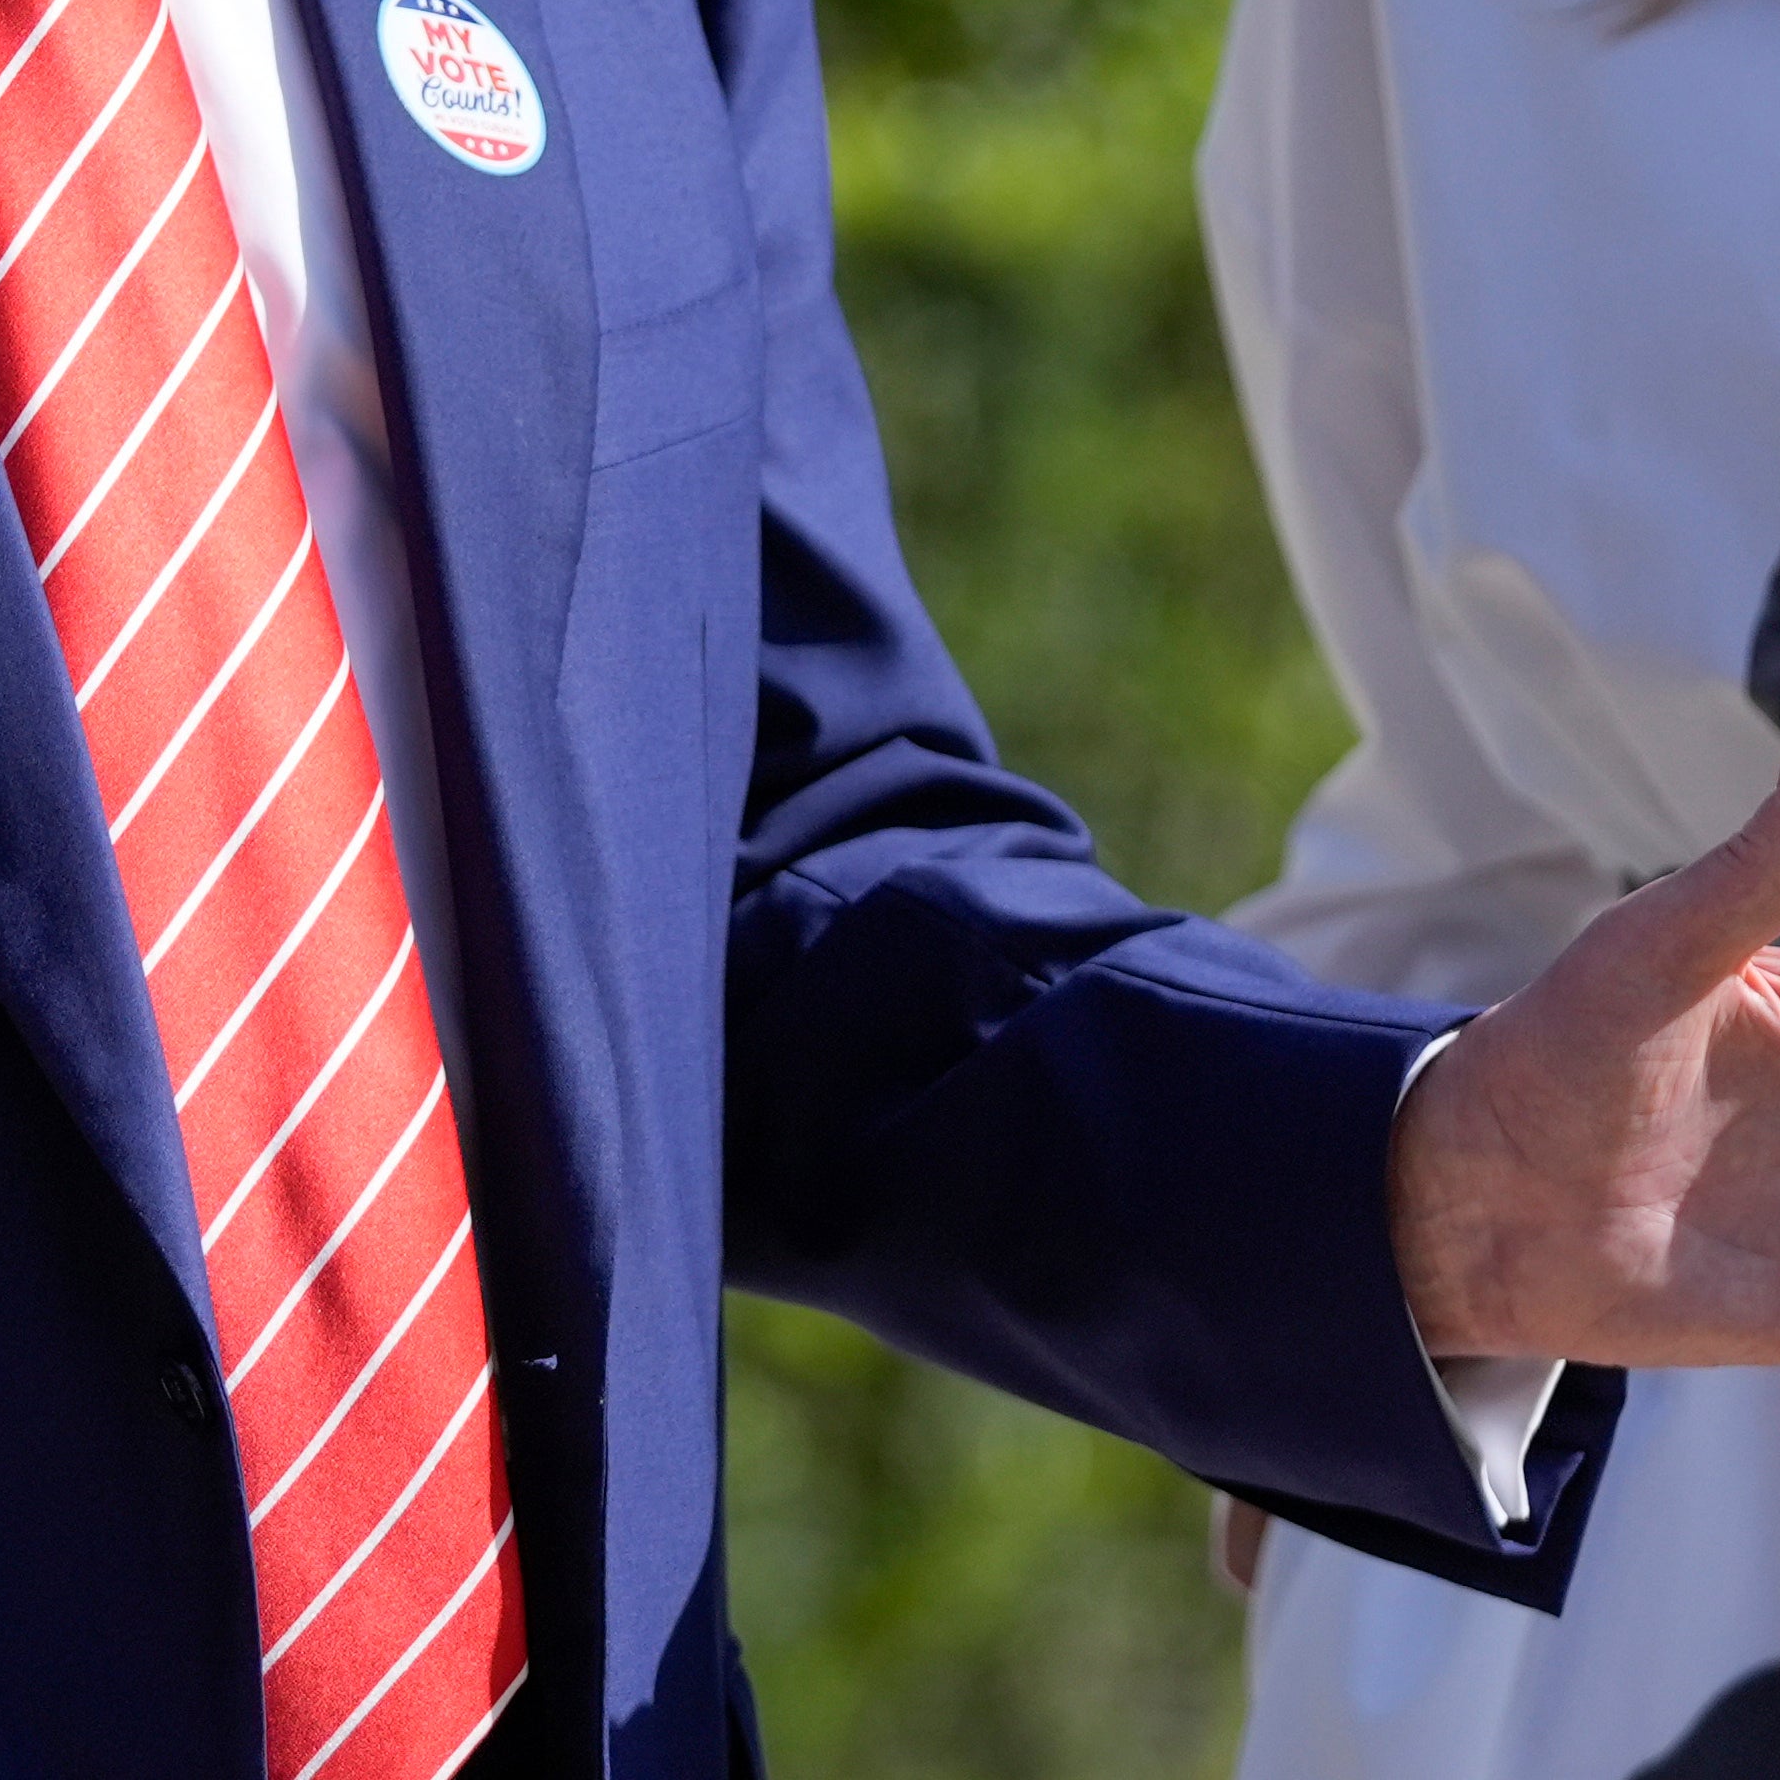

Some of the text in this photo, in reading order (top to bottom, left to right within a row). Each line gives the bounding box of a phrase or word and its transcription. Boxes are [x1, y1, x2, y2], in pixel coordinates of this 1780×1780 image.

[422, 19, 471, 53] MY
[410, 48, 512, 93] VOTE
[420, 75, 521, 118] Counts!
